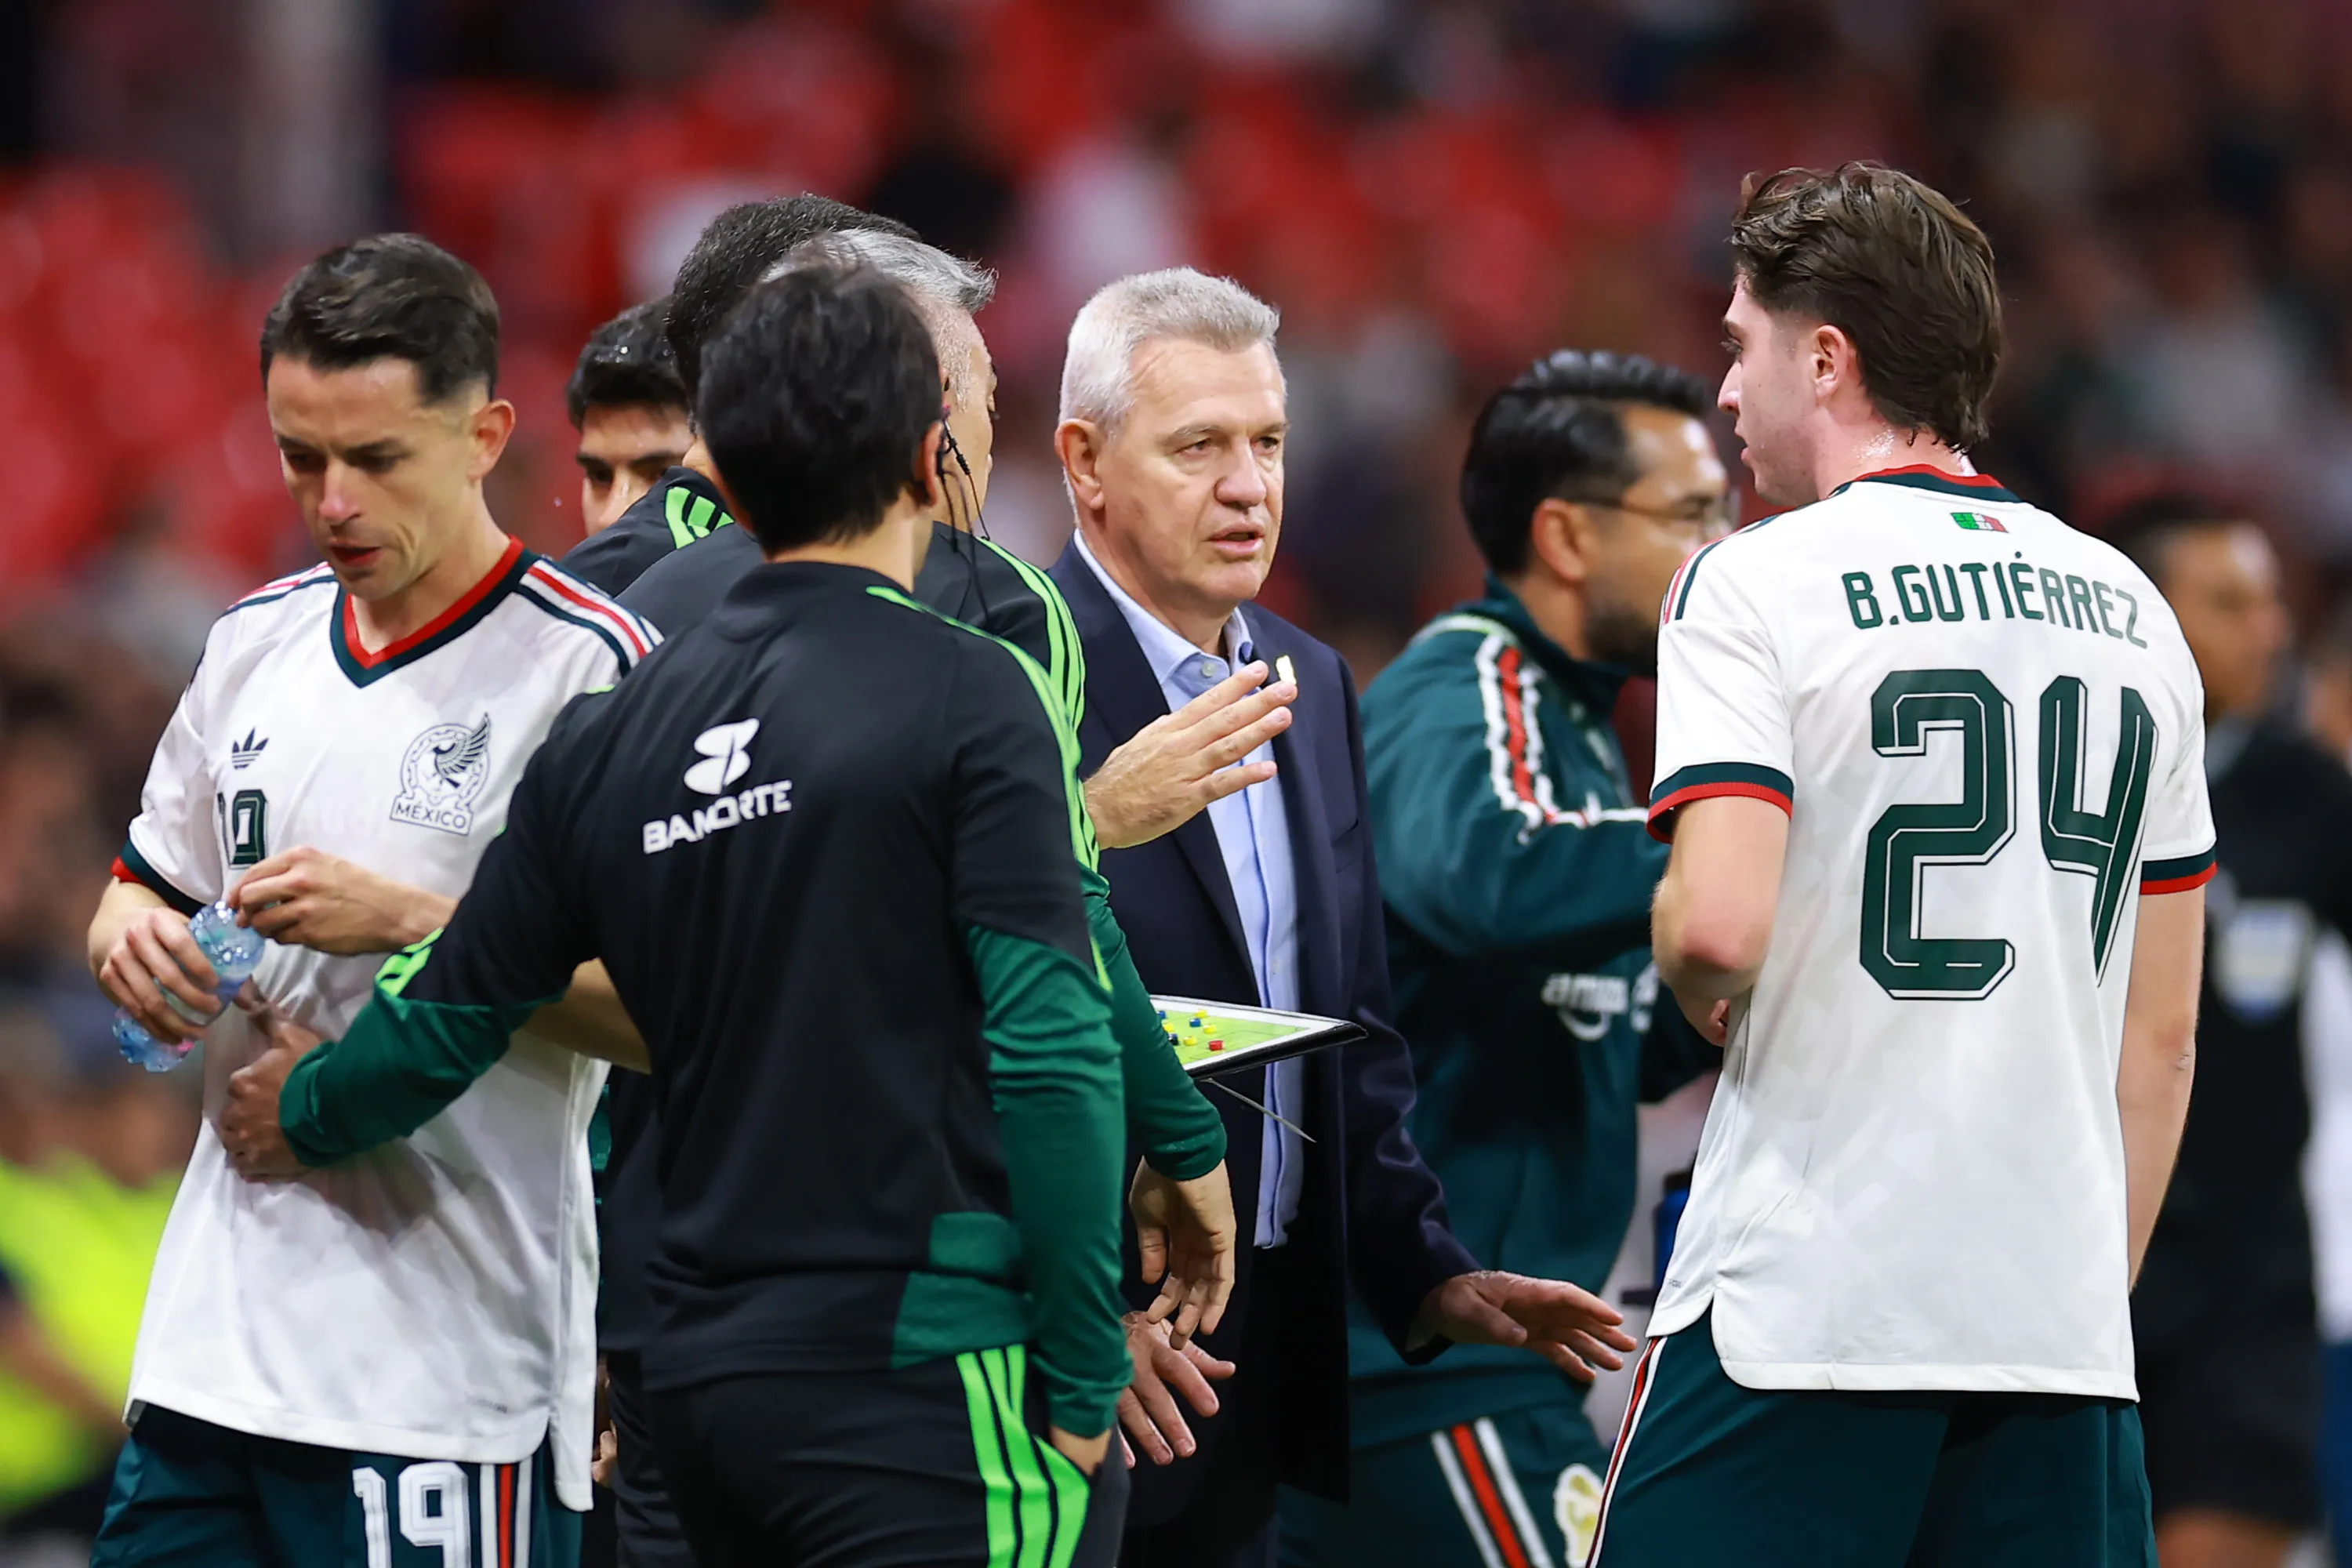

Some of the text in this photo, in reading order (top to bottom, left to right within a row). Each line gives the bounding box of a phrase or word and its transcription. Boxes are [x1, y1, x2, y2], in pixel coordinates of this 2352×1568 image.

[1841, 550, 2148, 649] B.GUTIÉRREZ
[395, 800, 467, 829] MÉXICO
[643, 779, 793, 855] BANORTE
[1859, 669, 2159, 1000] 24
[352, 1461, 471, 1568] 19
